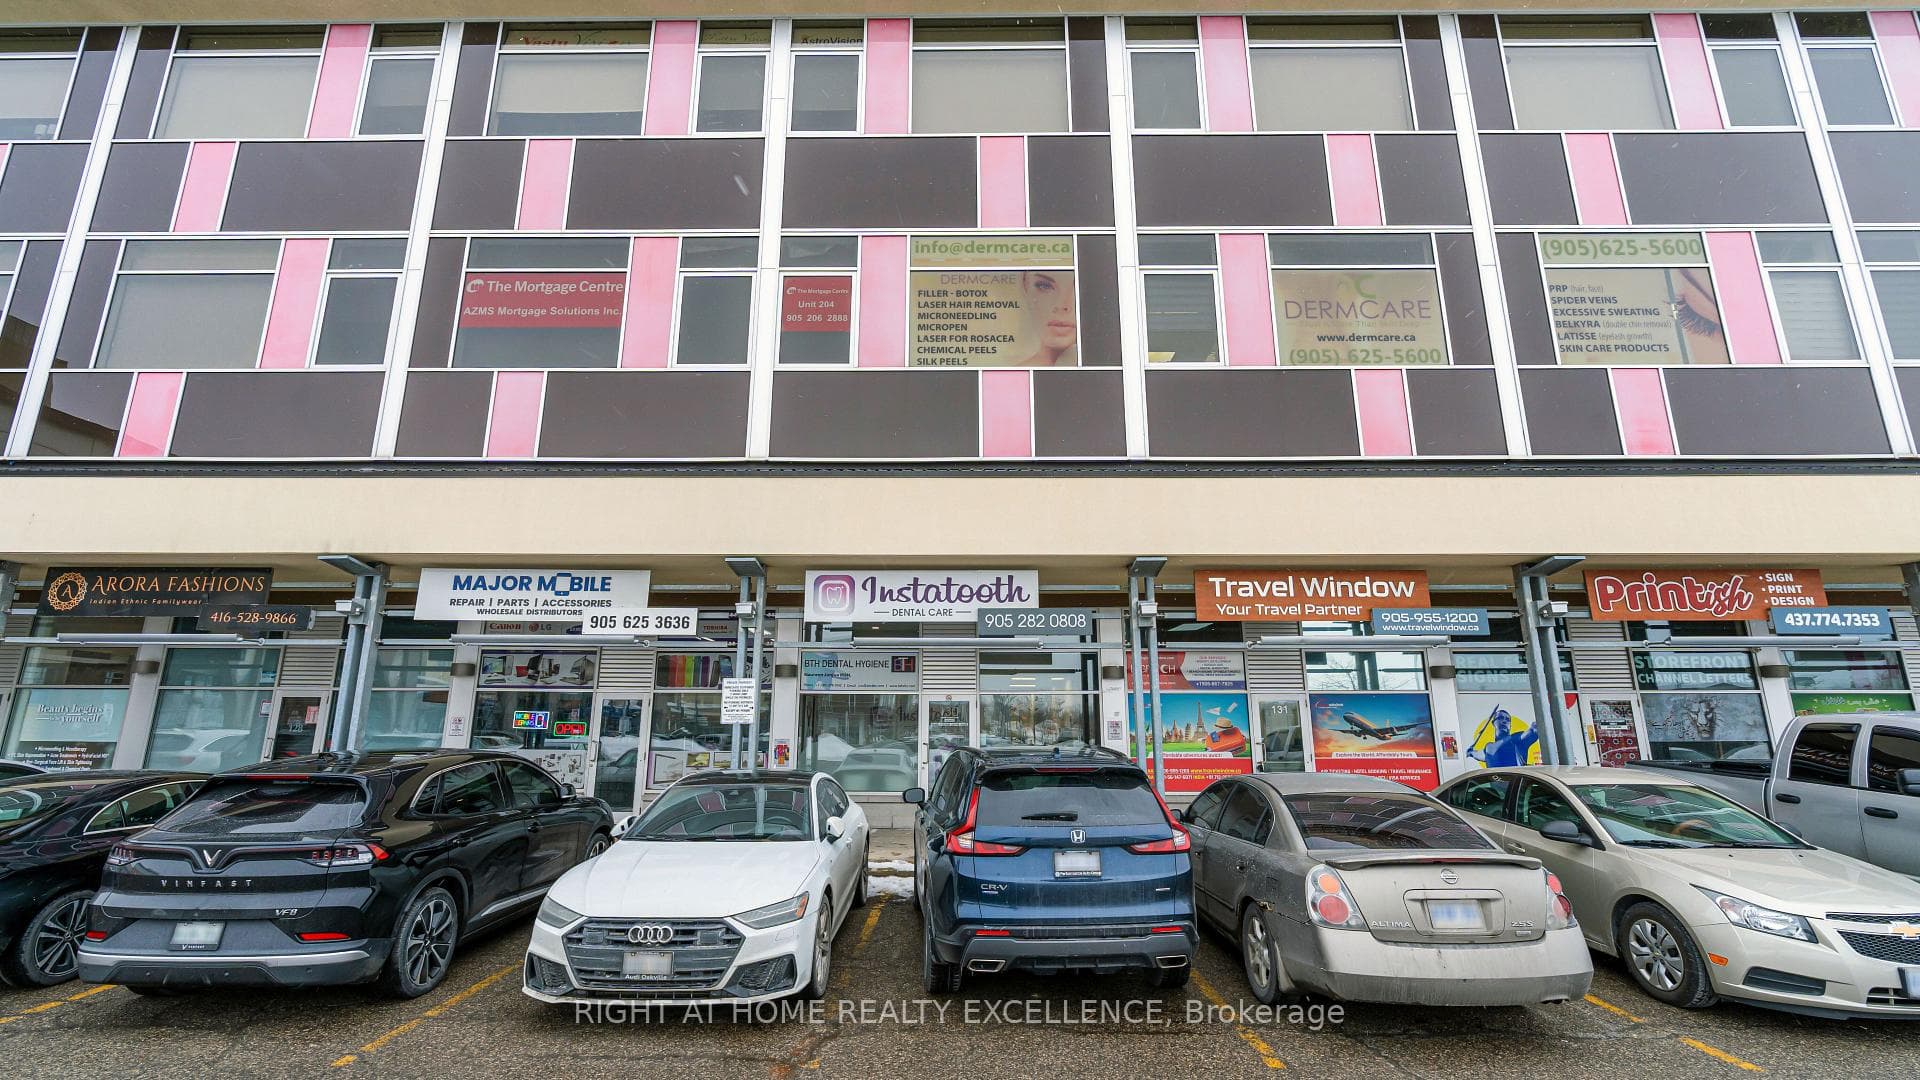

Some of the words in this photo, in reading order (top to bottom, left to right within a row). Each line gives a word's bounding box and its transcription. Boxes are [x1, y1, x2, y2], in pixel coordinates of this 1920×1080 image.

[915, 240, 1070, 254] info@dermcare.ca
[1542, 238, 1700, 259] (905)625-5600
[940, 274, 1016, 285] DERMCARE
[488, 281, 512, 292] The
[514, 281, 576, 294] Mortgage
[579, 281, 624, 292] Centre
[463, 307, 494, 315] AZMS
[498, 307, 546, 317] Mortgage
[550, 307, 600, 315] Solutions
[603, 307, 622, 316] Inc.
[1284, 300, 1431, 319] DERMCARE
[1317, 333, 1416, 342] www.dermcare.ca
[1290, 349, 1340, 365] (905)
[1346, 349, 1441, 364] 625-5600
[452, 575, 532, 591] MAJOR
[1765, 573, 1793, 582] SIGN
[92, 575, 160, 595] ARORA
[168, 576, 265, 592] FASHIONS
[861, 575, 1030, 604] Instatooth
[1209, 576, 1294, 597] Travel
[1301, 576, 1415, 598] Window
[1768, 585, 1802, 594] PRINT
[1595, 572, 1753, 618] Printish
[542, 599, 612, 608] ACCESSORIES
[1771, 597, 1815, 606] DESIGN
[892, 608, 926, 617] DENTAL
[928, 608, 953, 617] CARE
[1216, 604, 1251, 615] Your
[1255, 604, 1300, 615] Travel
[1306, 604, 1362, 616] Partner
[210, 612, 296, 624] 416-528-9866
[590, 616, 616, 629] 905
[623, 616, 649, 628] 625
[655, 616, 690, 629] 3636
[985, 614, 1013, 628] 905
[1018, 614, 1045, 628] 282
[1050, 614, 1086, 628] 0808
[1382, 613, 1478, 622] 905-955-1200
[1785, 613, 1880, 627] 437.774.7353
[1635, 655, 1750, 668] STOREFRONT
[1638, 674, 1697, 684] CHANNEL
[1701, 674, 1753, 684] LETTERS
[38, 704, 69, 714] Beauty
[72, 704, 103, 714] begins
[1272, 705, 1288, 714] 131
[161, 879, 253, 887] VINFAST
